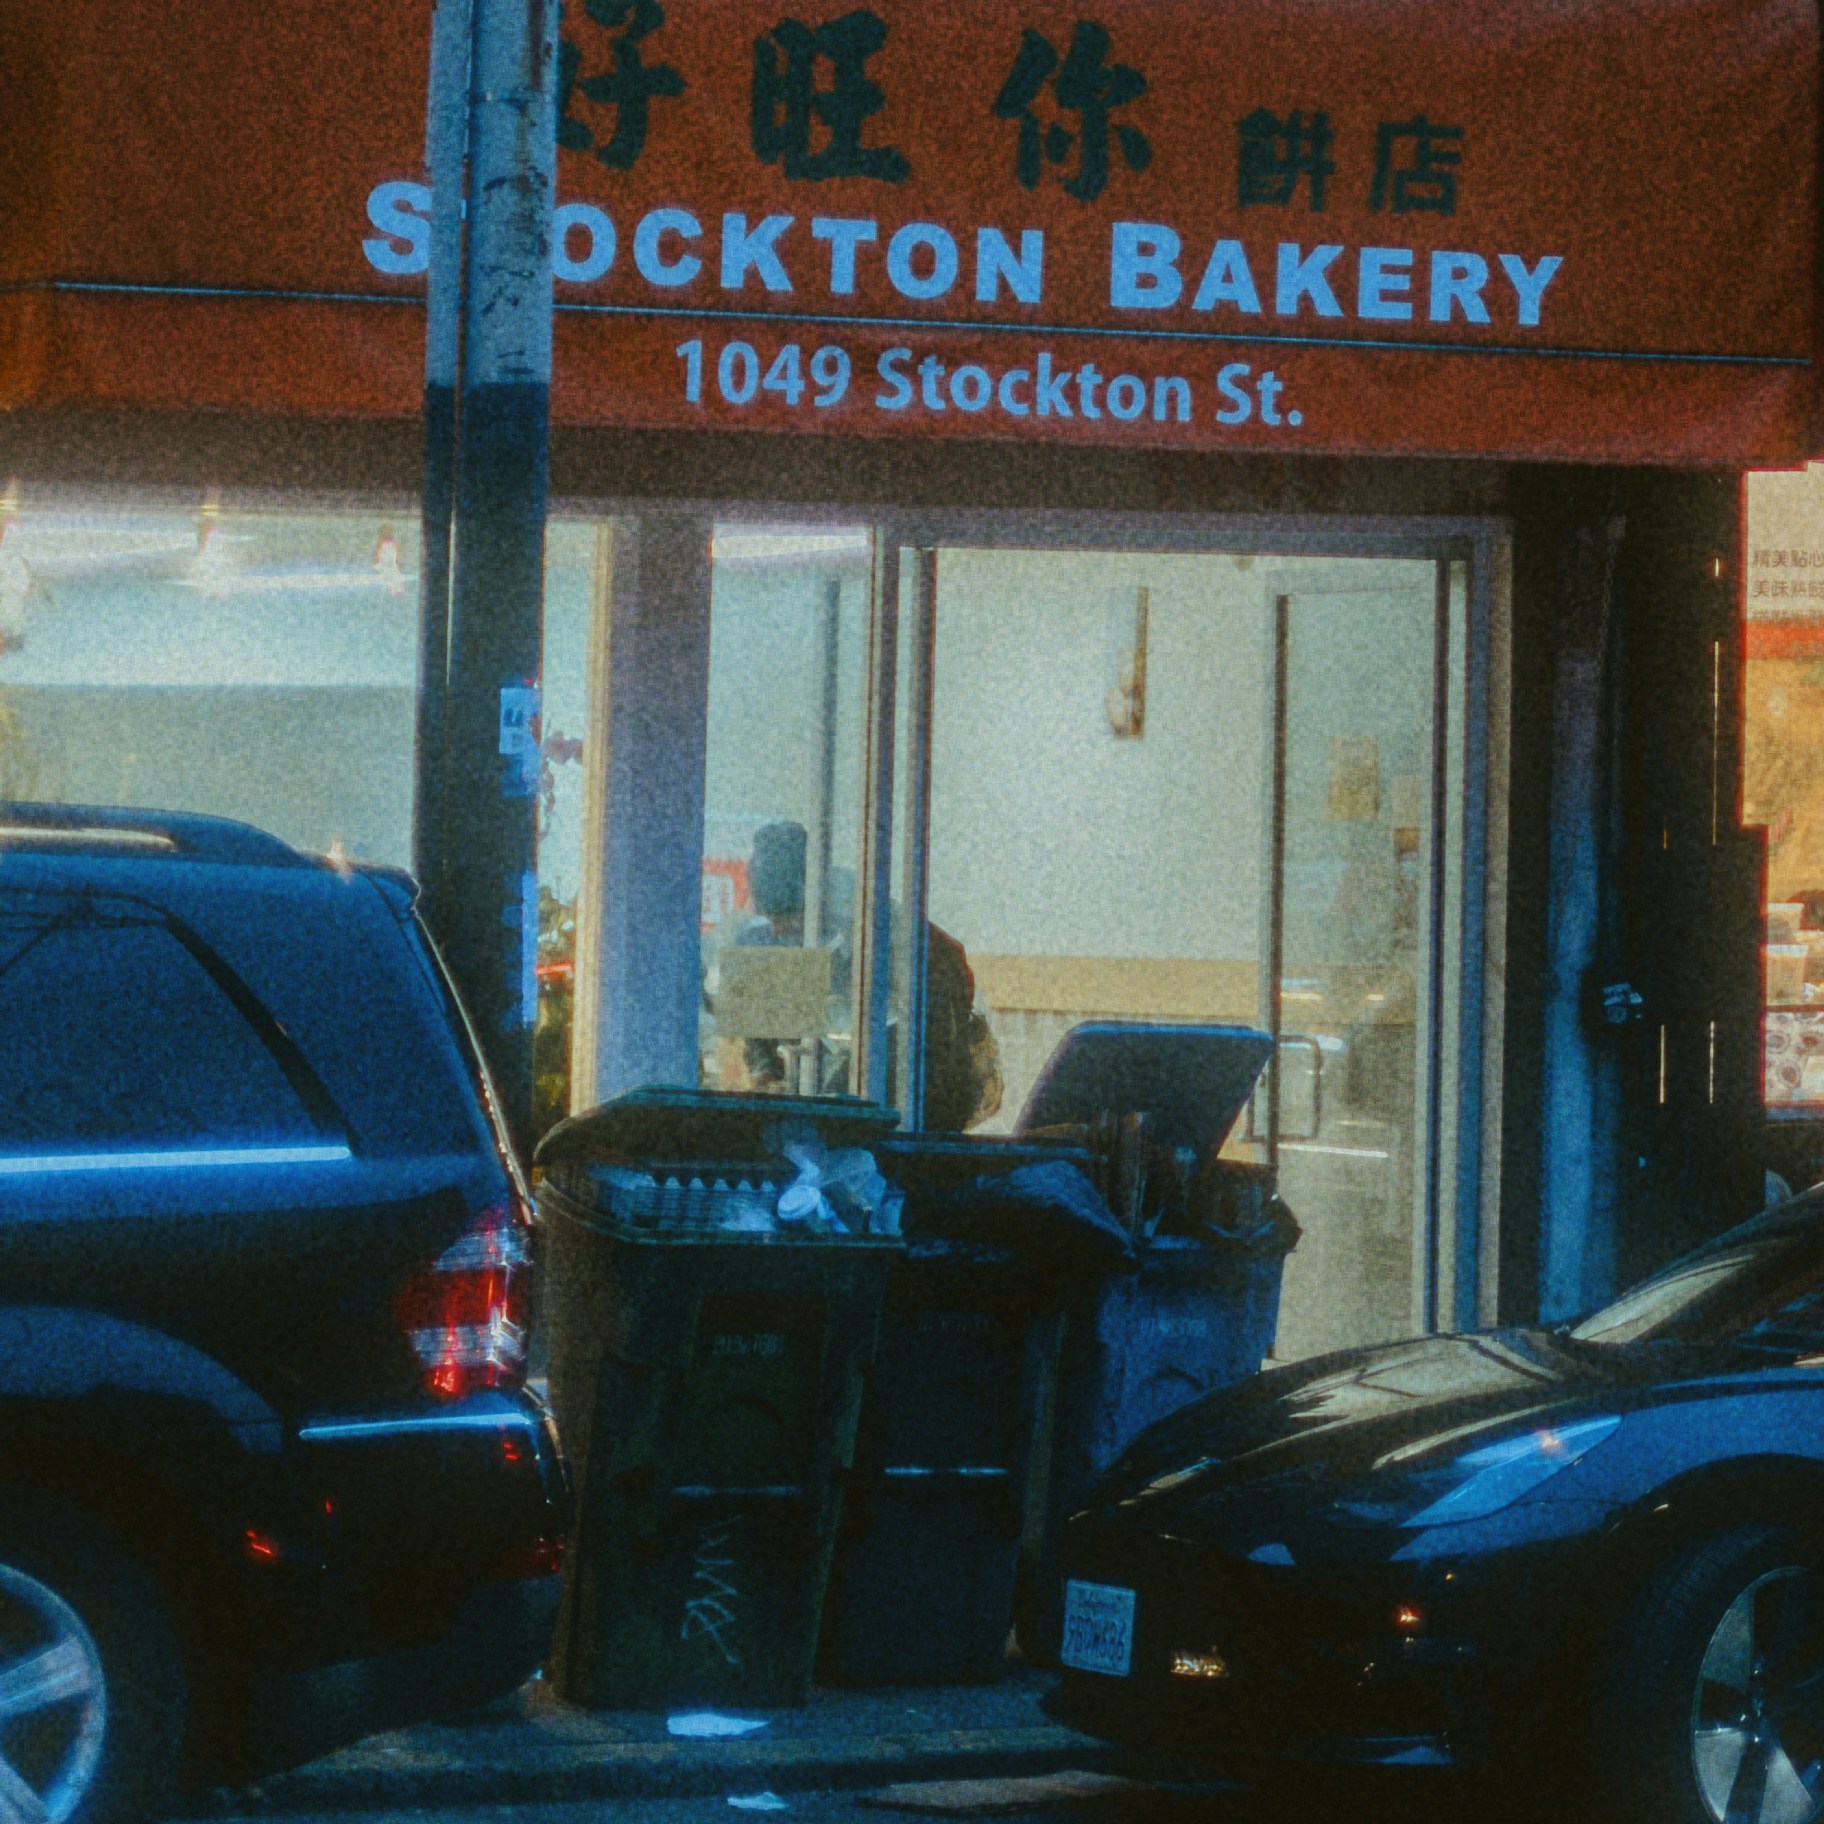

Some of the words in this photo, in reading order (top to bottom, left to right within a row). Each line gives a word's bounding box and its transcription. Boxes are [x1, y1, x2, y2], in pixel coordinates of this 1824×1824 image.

[362, 180, 1044, 304] SOCKTON
[1110, 220, 1565, 327] BAKERY
[676, 339, 852, 408] 1049
[874, 348, 1191, 423] Stockton
[1215, 363, 1303, 427] St.
